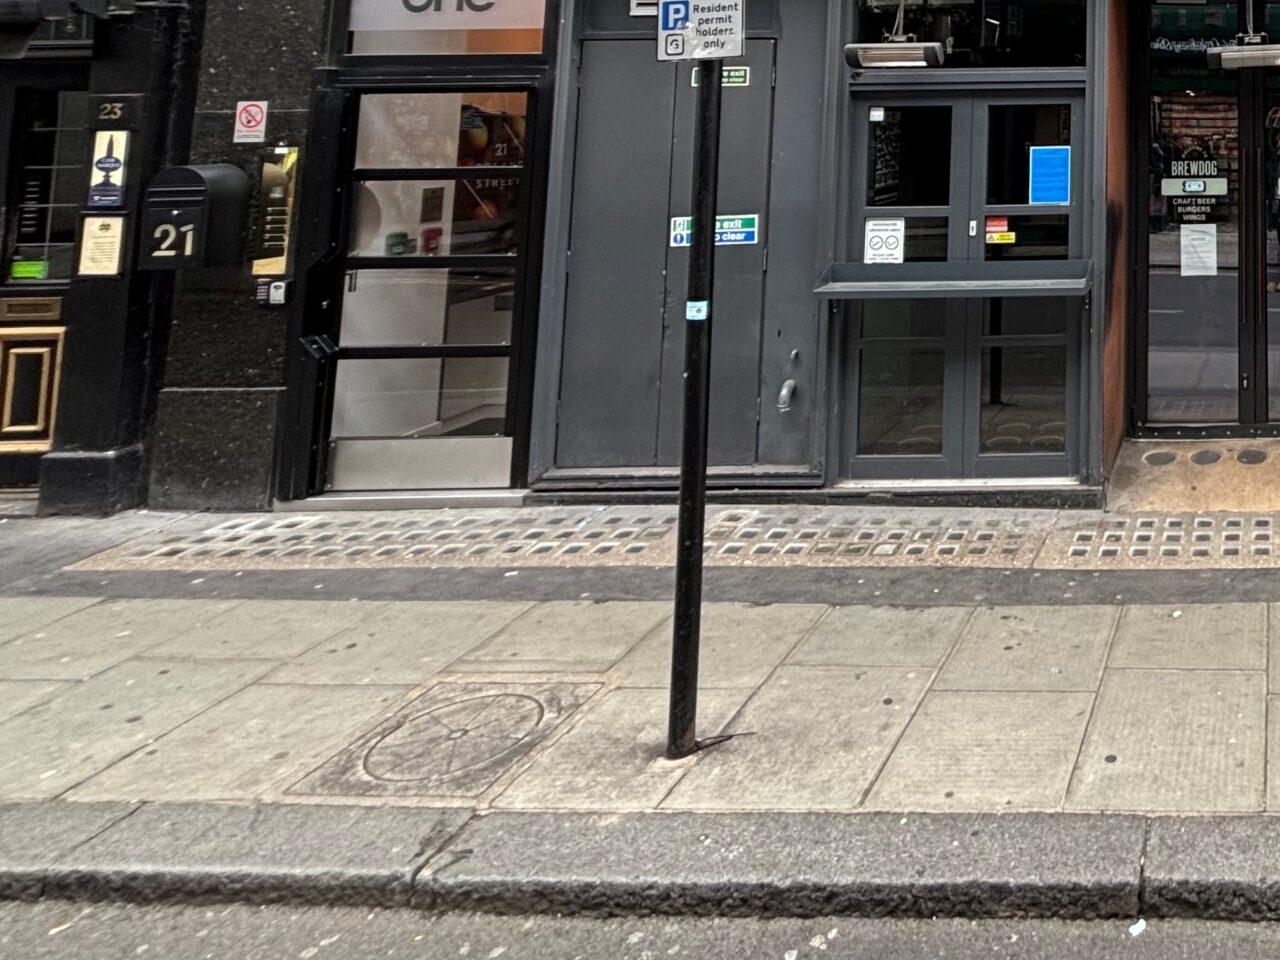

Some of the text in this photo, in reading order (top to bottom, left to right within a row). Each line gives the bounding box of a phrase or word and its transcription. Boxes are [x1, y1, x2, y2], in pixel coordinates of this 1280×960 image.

[693, 2, 739, 13] Resident
[668, 3, 686, 28] P
[698, 14, 732, 26] permit
[696, 27, 734, 37] holders
[704, 38, 725, 49] only
[99, 103, 123, 120] 23
[495, 144, 508, 155] 21
[1171, 161, 1217, 176] BREWDOG
[722, 220, 742, 229] exit
[152, 224, 194, 256] 21
[721, 232, 746, 241] clear
